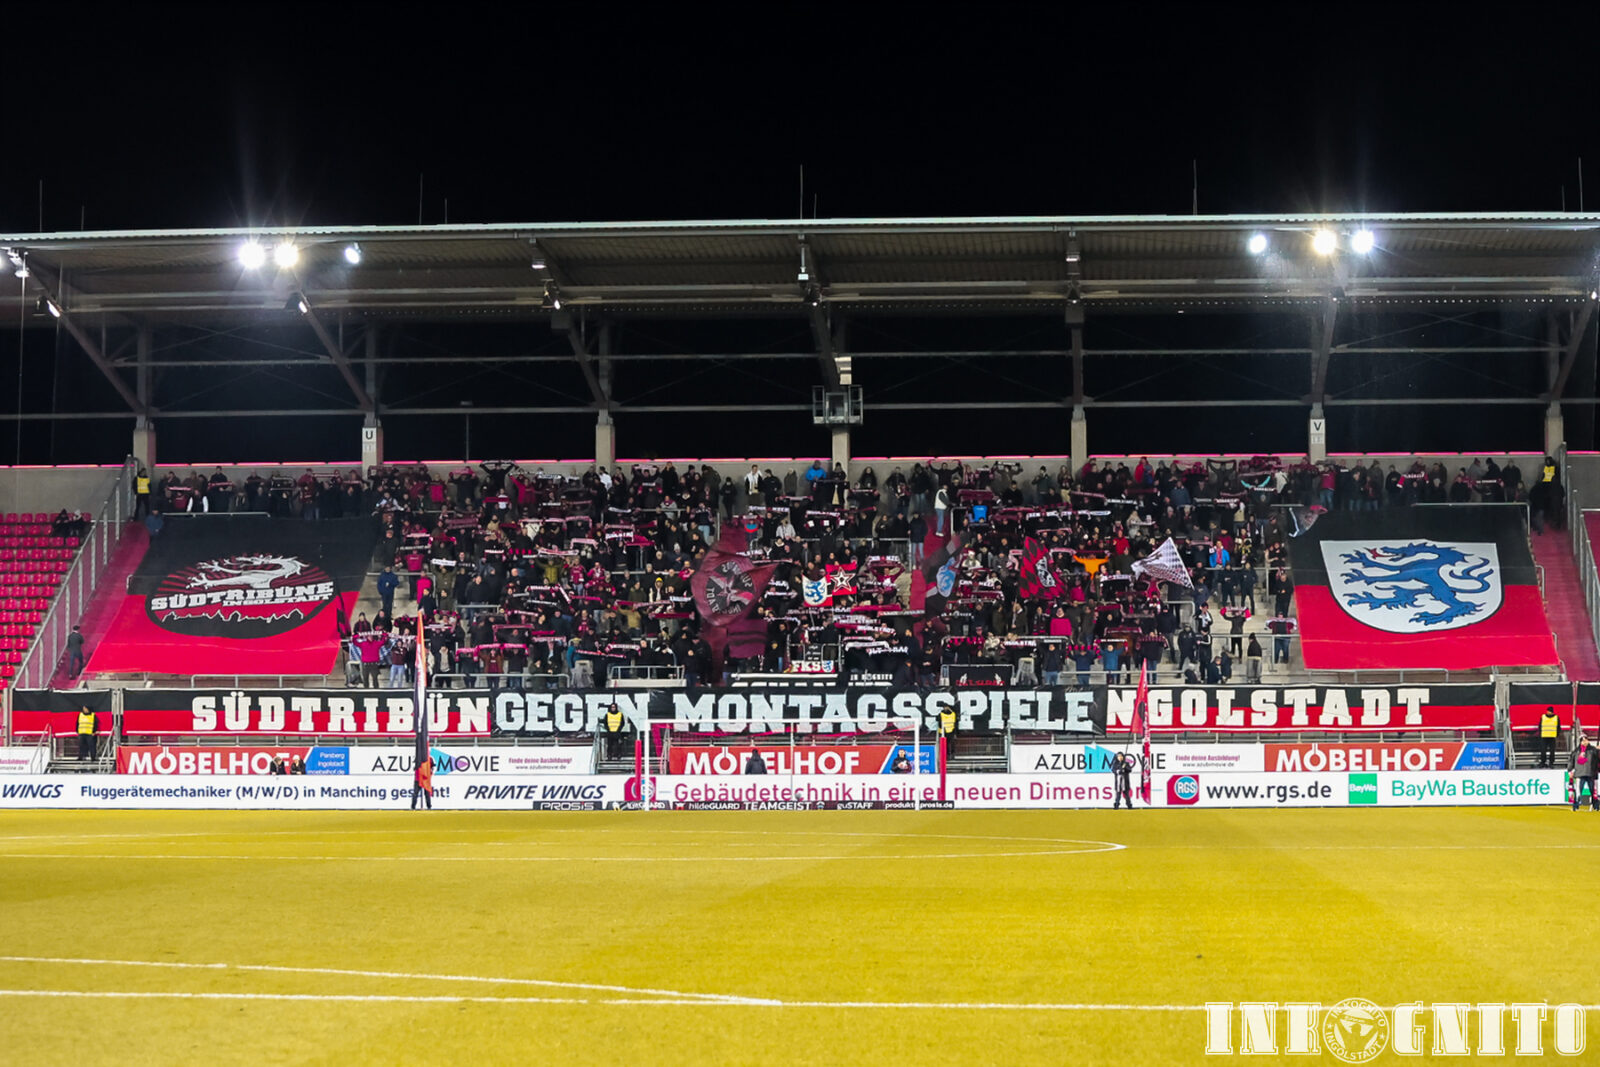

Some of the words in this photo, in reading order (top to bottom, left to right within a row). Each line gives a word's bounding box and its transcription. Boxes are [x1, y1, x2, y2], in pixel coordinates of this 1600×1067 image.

[1313, 421, 1322, 431] V
[365, 430, 374, 440] U
[151, 581, 334, 611] SÜDTRIBÜNE
[791, 660, 821, 672] FKS
[495, 692, 650, 733] GEGEN
[673, 690, 1094, 733] MONTAGSSPIELE
[1035, 753, 1093, 770] AZUBI
[1275, 744, 1444, 771] MÖBELHOF
[2, 784, 64, 799] WINGS
[80, 786, 232, 799] Fluggerätemechaniker
[235, 786, 299, 799] (M/W/D)
[303, 786, 316, 797] in
[321, 786, 387, 800] Manching
[391, 787, 450, 800] gesht!
[464, 785, 538, 799] PRIVATE
[541, 785, 607, 799] WINGS
[674, 783, 853, 801] Gebäudetechnik
[861, 783, 880, 800] in
[954, 785, 1021, 800] neuen
[1030, 782, 1143, 800] Dimensn
[1177, 782, 1197, 794] RGS
[1206, 782, 1332, 802] www.rgs.de
[1391, 780, 1456, 800] BayWa
[1462, 778, 1551, 796] Baustoffe
[744, 801, 812, 811] TEAMGEIST
